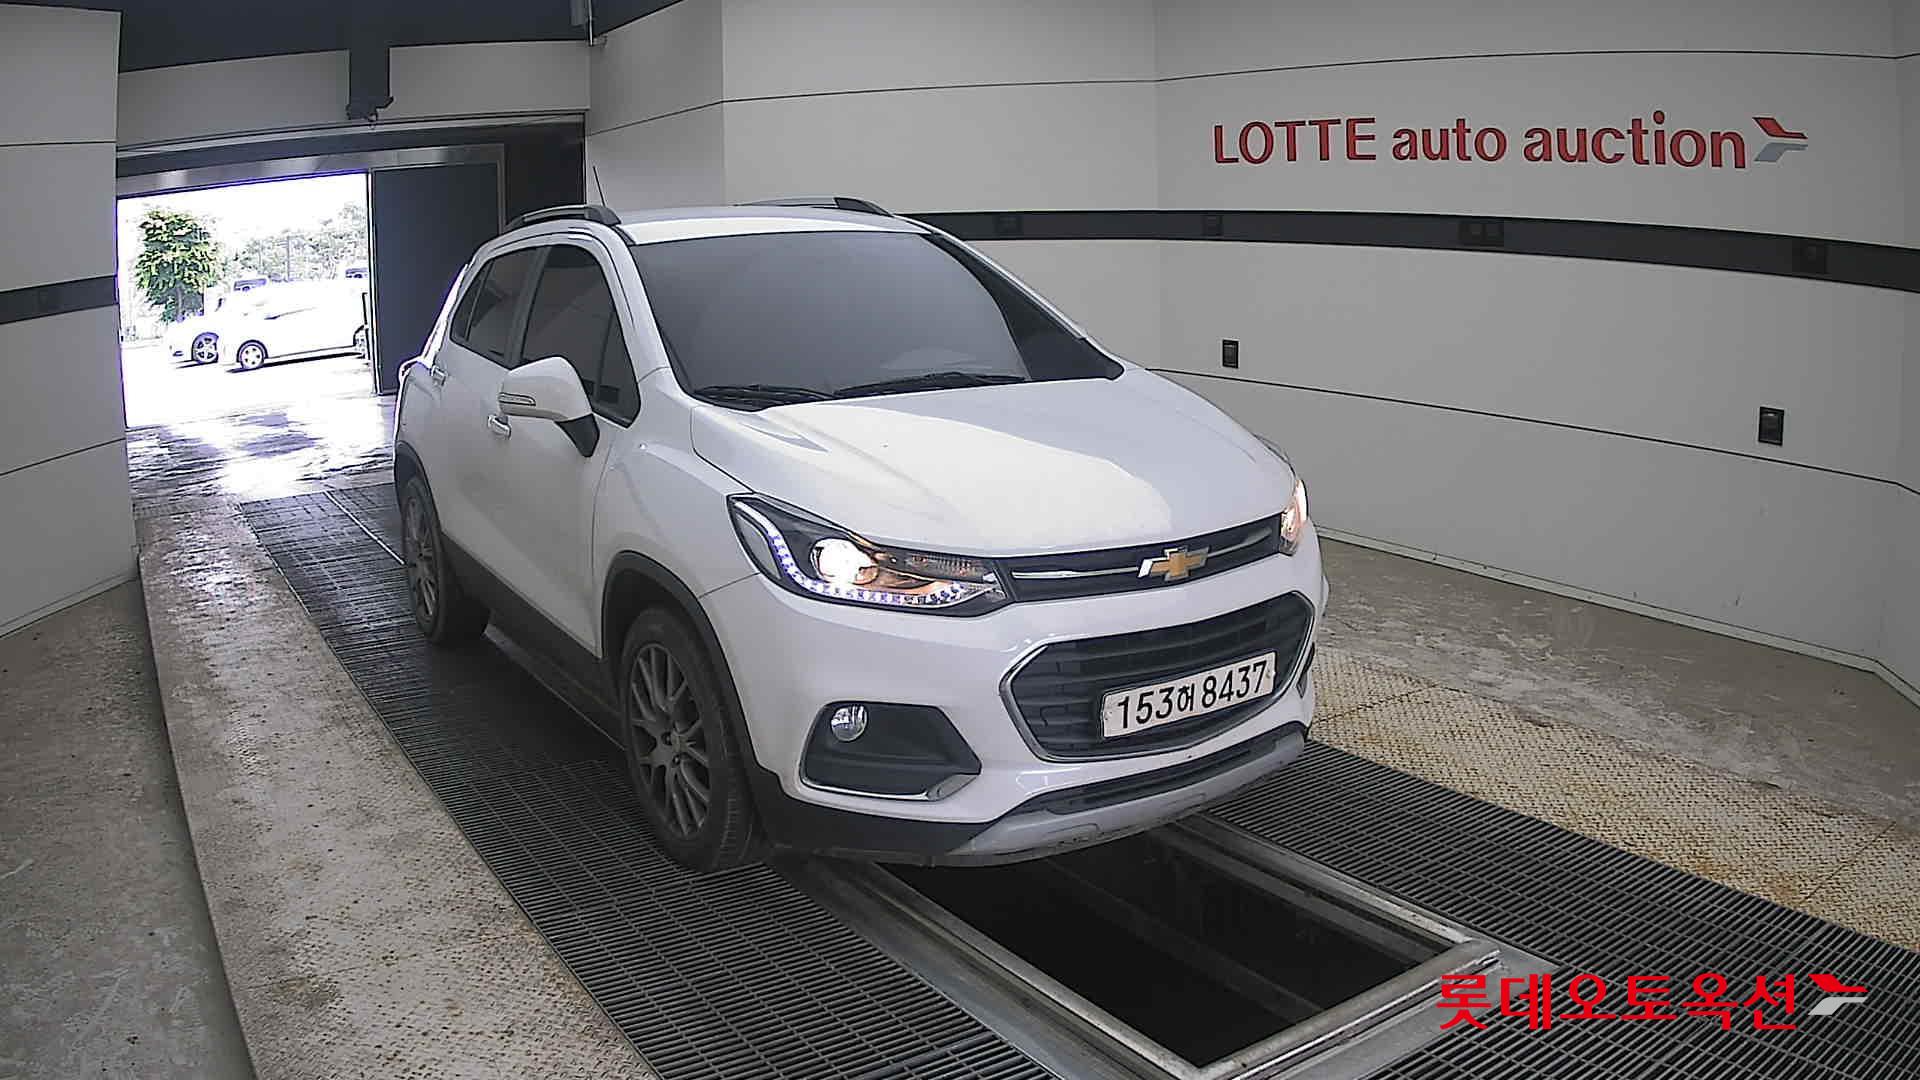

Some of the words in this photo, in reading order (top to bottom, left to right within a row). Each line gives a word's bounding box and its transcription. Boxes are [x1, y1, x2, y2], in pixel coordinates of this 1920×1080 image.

[1213, 116, 1377, 165] LOTTE
[1391, 118, 1509, 163] auto
[1522, 110, 1747, 169] auction
[1201, 660, 1267, 709] 8437
